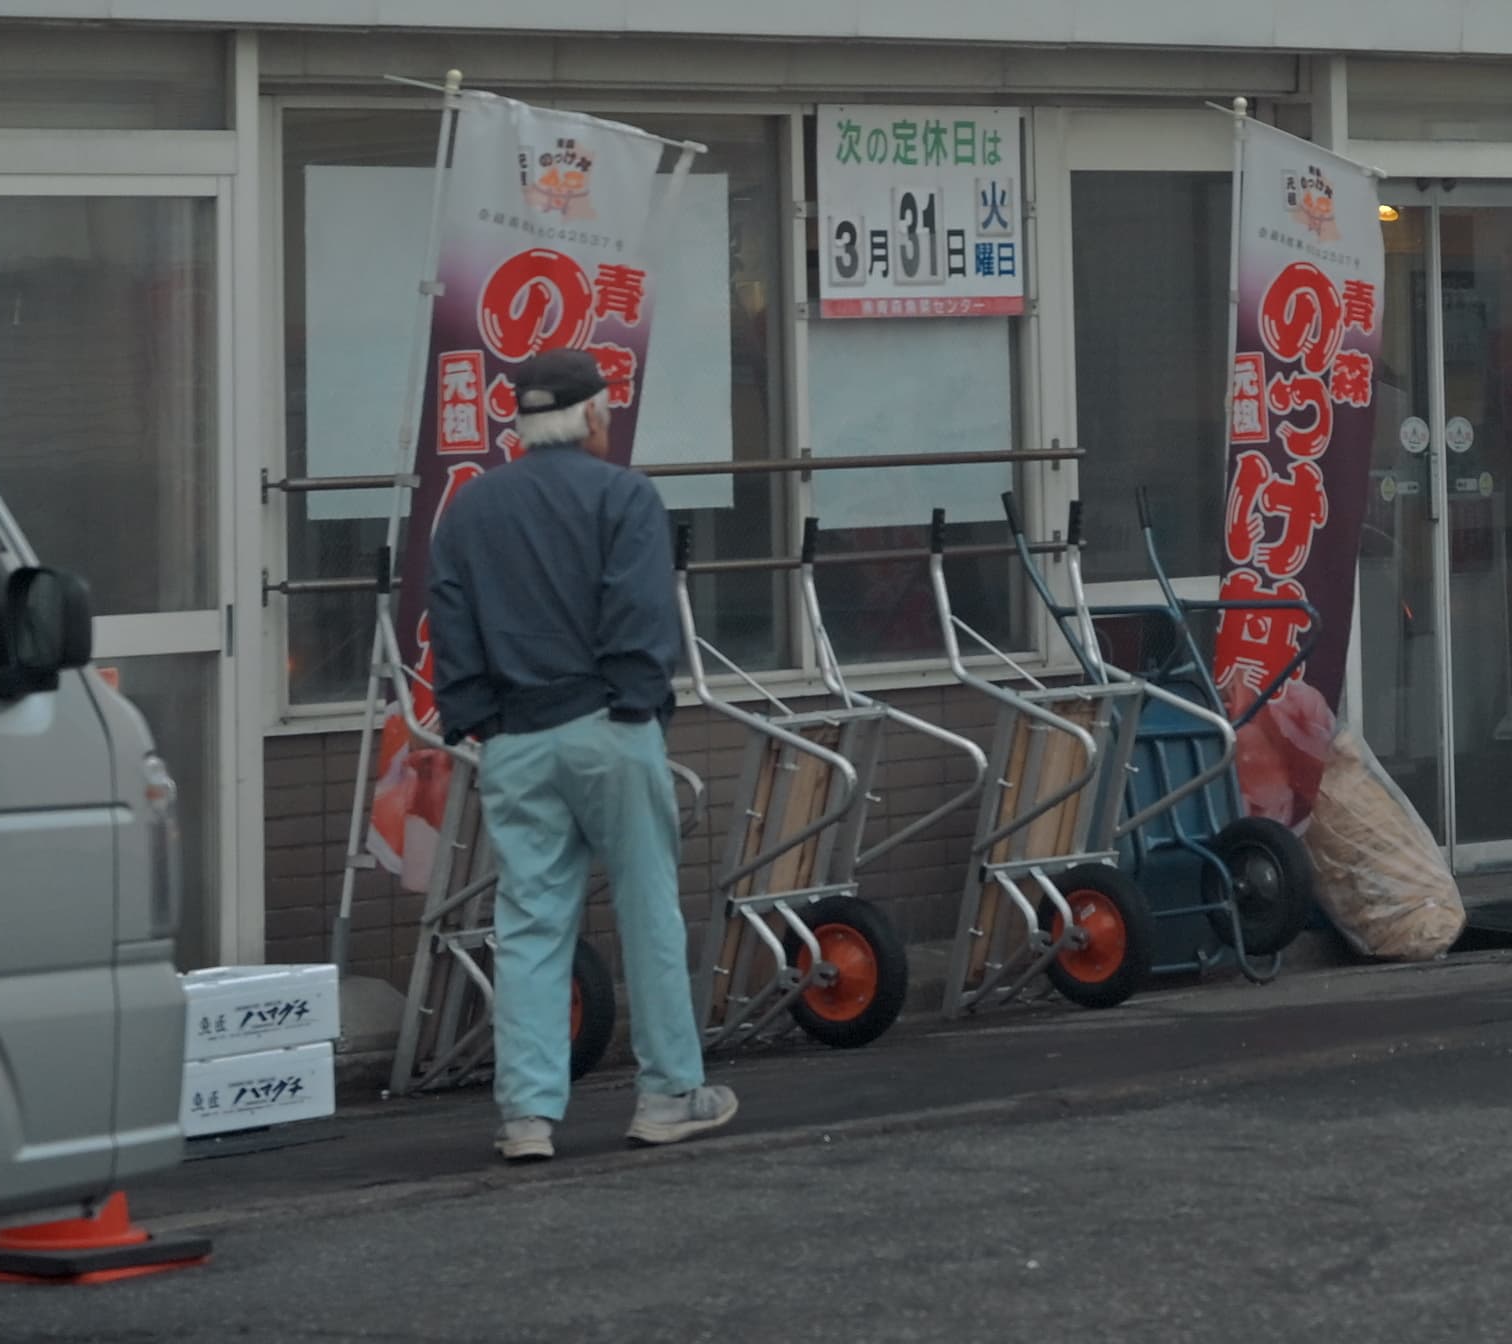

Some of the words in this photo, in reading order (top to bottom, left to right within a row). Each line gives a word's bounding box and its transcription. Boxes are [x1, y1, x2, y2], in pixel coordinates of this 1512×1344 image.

[836, 120, 1002, 166] 次の定休日は
